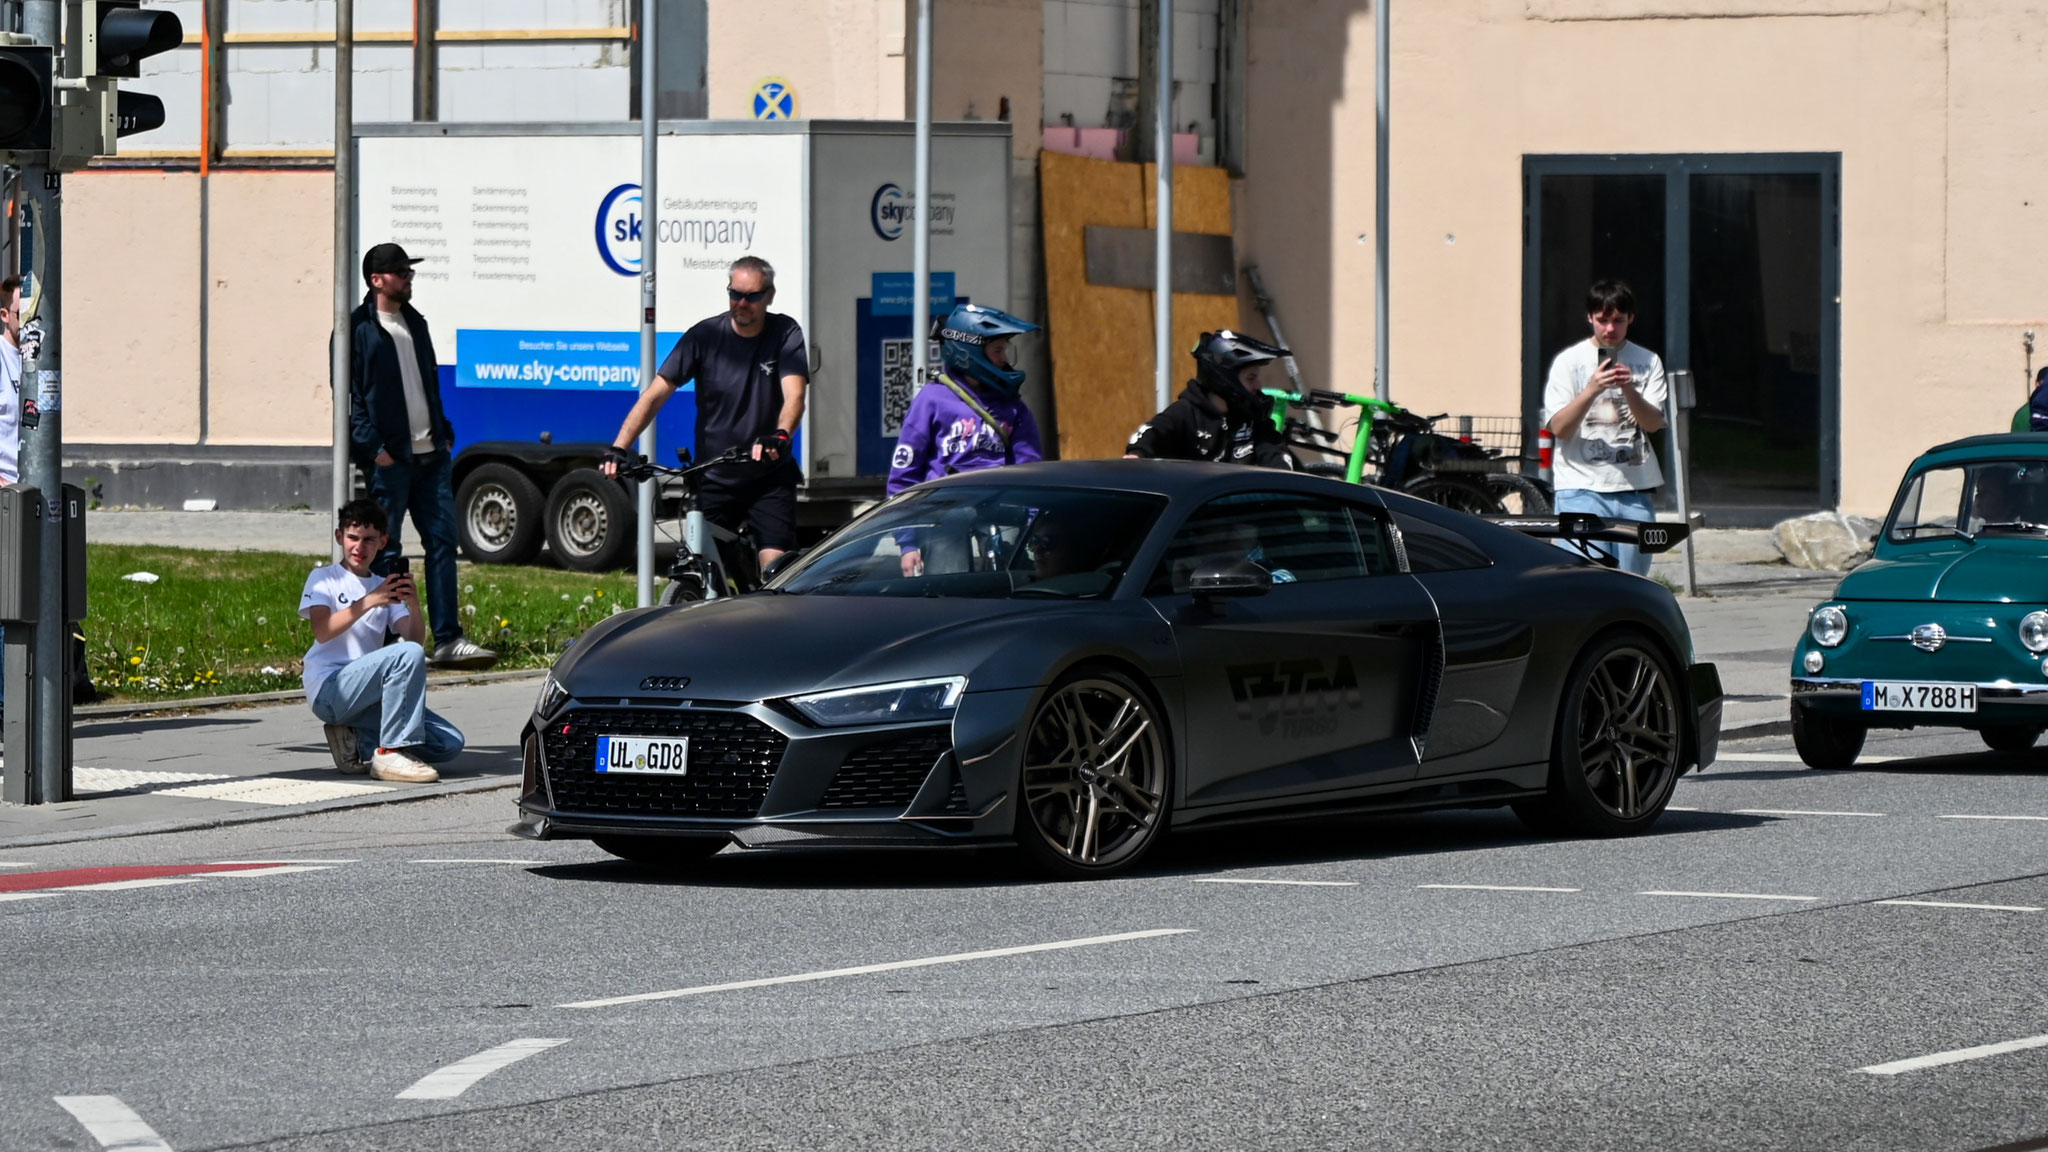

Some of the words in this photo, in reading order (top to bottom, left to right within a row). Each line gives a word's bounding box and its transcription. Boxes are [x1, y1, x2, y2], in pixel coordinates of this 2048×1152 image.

[472, 203, 529, 214] Deckenreinigung
[663, 198, 758, 213] Gebäudereinigung
[391, 220, 443, 231] Grundreinigung
[472, 220, 529, 231] Fensterreinigung
[472, 238, 531, 248] Jalousiereinigung
[473, 254, 530, 265] Teppichreinigung
[472, 271, 536, 283] Fassadenreinigung
[519, 340, 555, 351] Besuchen
[556, 341, 568, 351] Sie
[569, 342, 594, 351] unsere
[595, 341, 630, 352] Webseite
[475, 359, 642, 387] www.sky-company
[1874, 686, 1888, 707] M
[610, 741, 633, 768] UL
[647, 743, 683, 770] GD8
